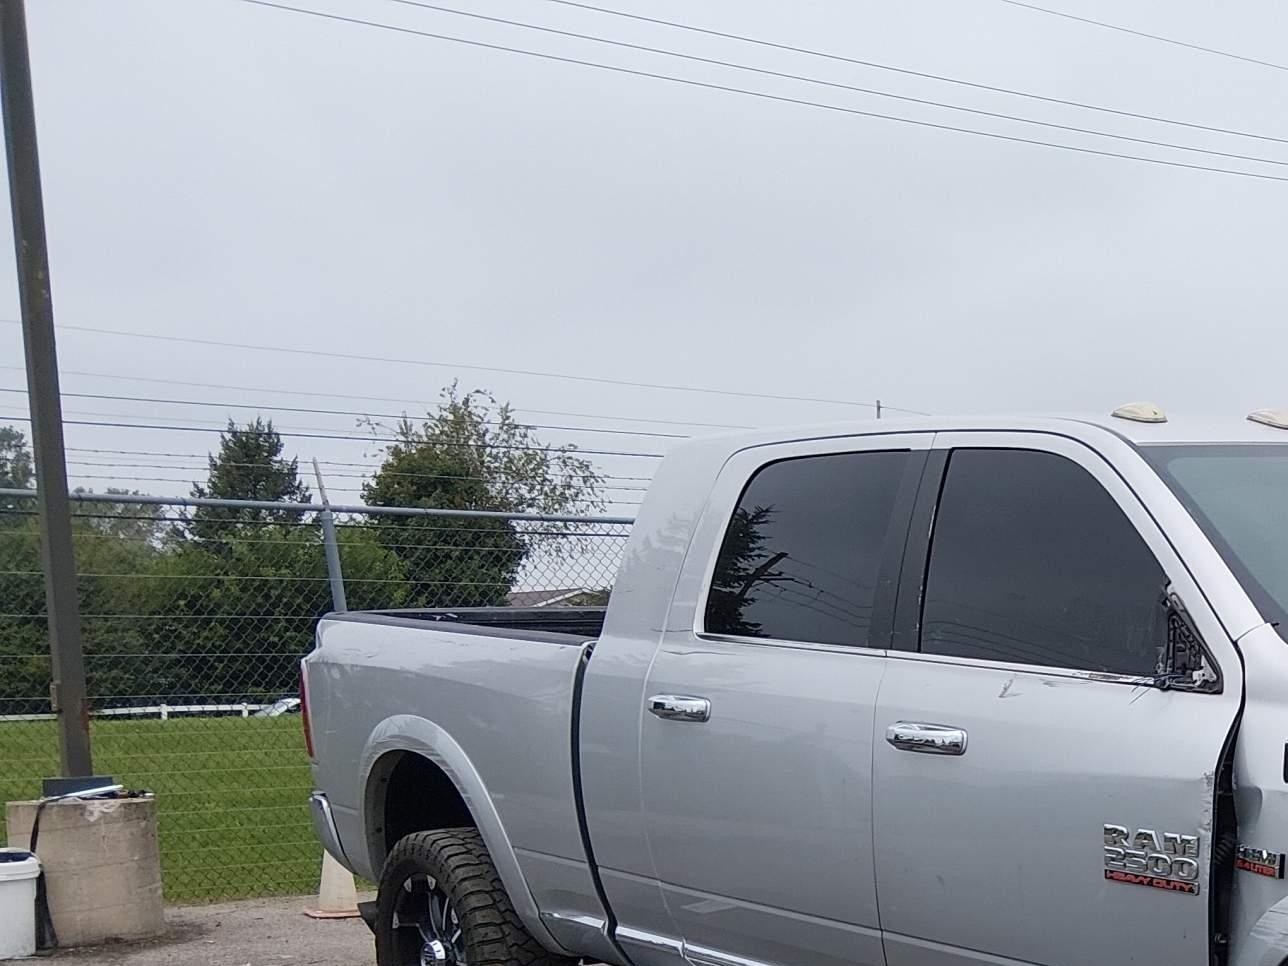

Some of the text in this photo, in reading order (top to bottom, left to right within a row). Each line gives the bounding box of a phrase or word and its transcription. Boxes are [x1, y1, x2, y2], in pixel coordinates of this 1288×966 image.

[1104, 823, 1200, 858] RAM
[1104, 846, 1199, 880] 2500
[1106, 870, 1194, 893] HEAVY DUTY
